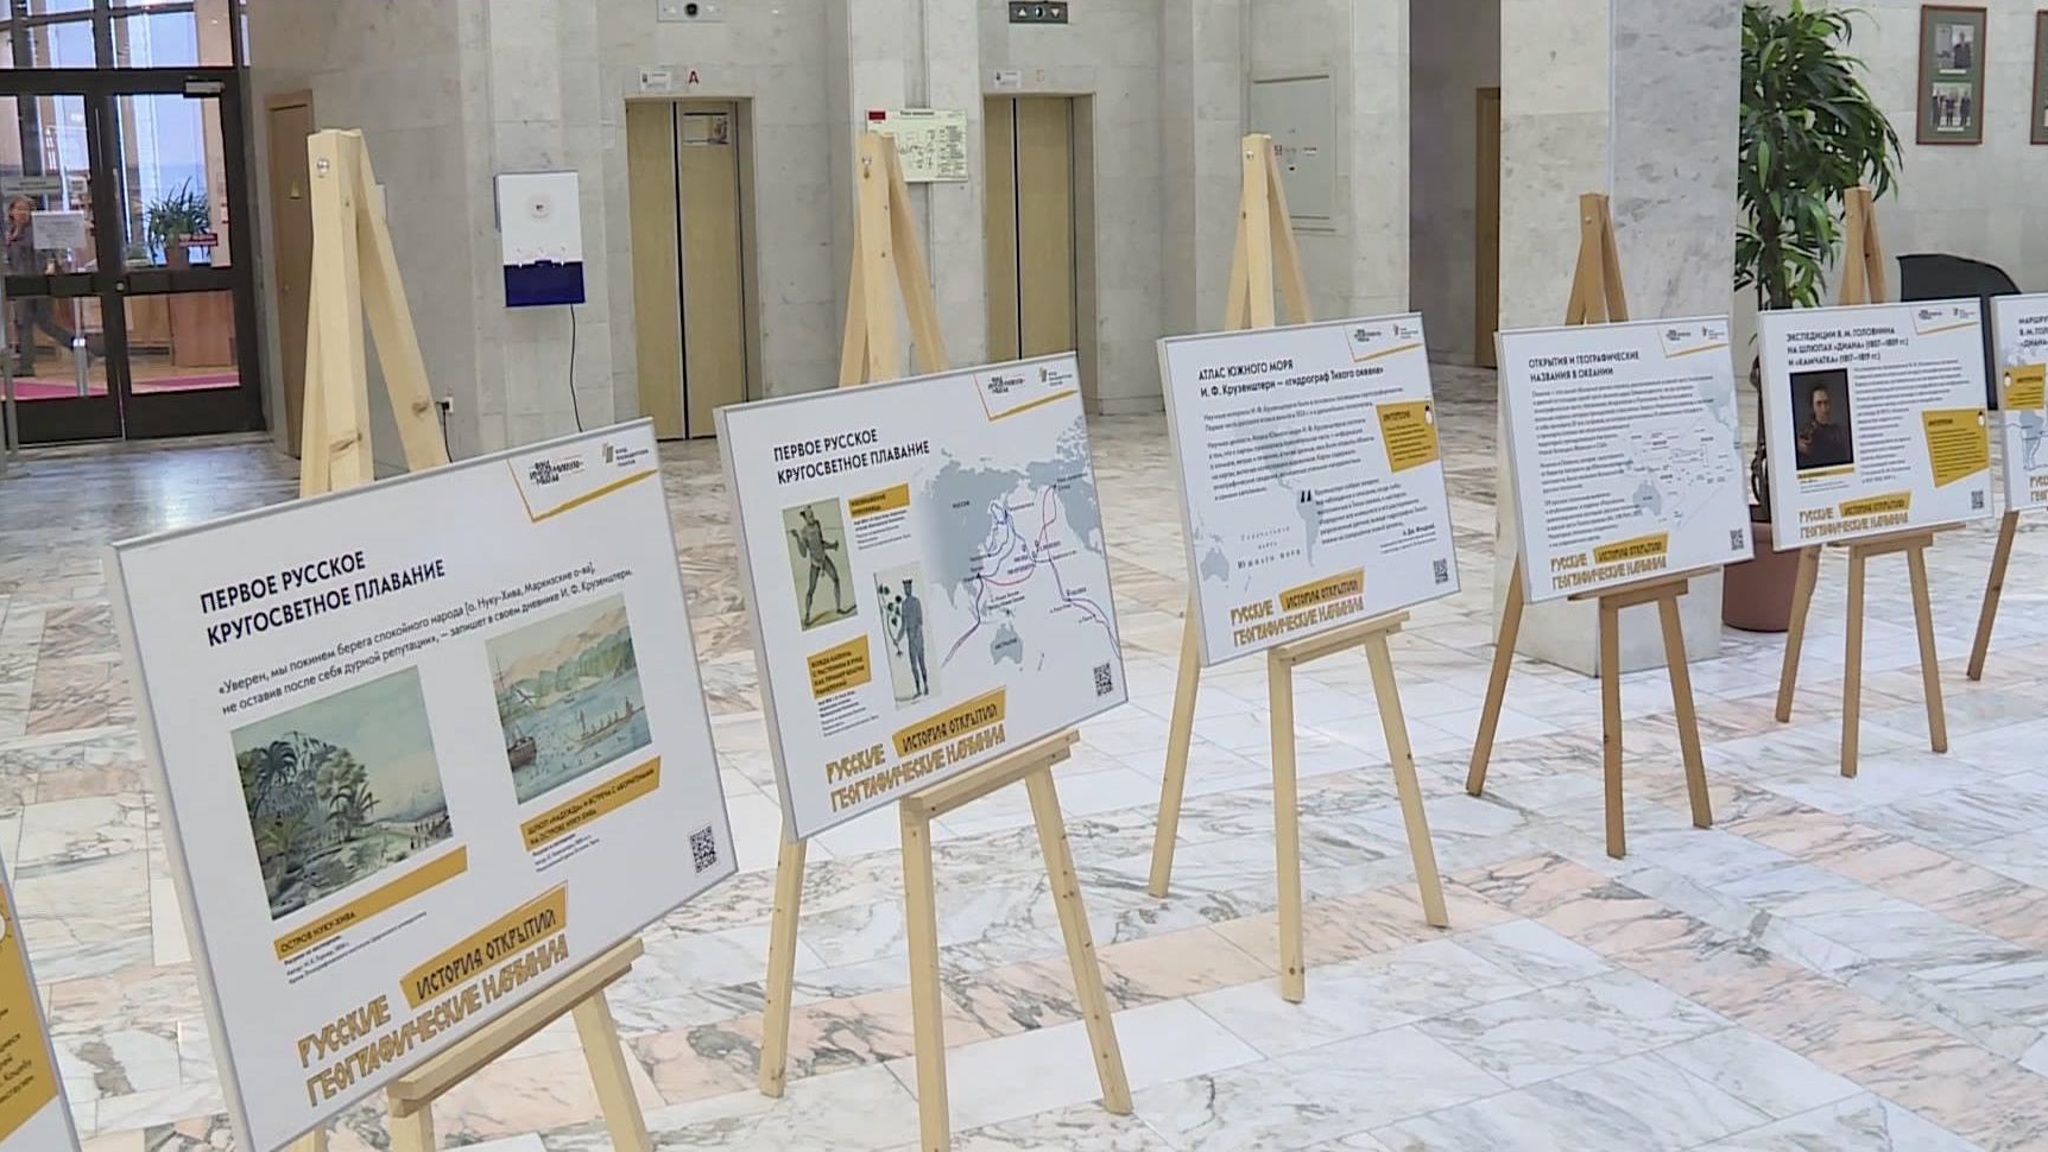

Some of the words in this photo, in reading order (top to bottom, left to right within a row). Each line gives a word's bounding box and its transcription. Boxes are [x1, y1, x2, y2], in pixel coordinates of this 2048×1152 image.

[689, 70, 699, 84] А
[1787, 331, 1835, 342] ЭКСПЕДИЦИИ
[1853, 327, 1895, 337] ГОЛОВНИНА
[1788, 346, 1797, 354] НА
[1799, 343, 1832, 354] ШЛЮПАХ
[1199, 367, 1226, 380] АТЛАС
[1228, 362, 1267, 377] ЮЖНОГО
[1270, 359, 1293, 371] МОРЯ
[1529, 356, 1567, 368] ОТКРЫТИЯ
[1576, 350, 1639, 364] ГЕОГРАФИЧЕСКИЕ
[1530, 370, 1571, 381] НАЗВАНИЯ
[1578, 367, 1613, 378] ОКЕАНИИ
[1222, 381, 1275, 396] Крузенштерн
[774, 439, 822, 462] ПЕРВОЕ
[824, 428, 878, 452] РУССКОЕ
[777, 453, 868, 485] КРУГОСВЕТНОЕ
[870, 440, 930, 465] ПЛАВАНИЕ
[201, 575, 278, 614] ПЕРВОЕ
[282, 550, 366, 591] РУССКОЕ
[207, 587, 351, 647] КРУГОСВЕТНОЕ
[355, 559, 445, 601] ПЛАВАНИЕ
[219, 672, 270, 694] «Уверен,
[271, 665, 288, 678] мы
[290, 651, 336, 673] покинем
[337, 636, 373, 656] берега
[374, 618, 429, 644] спокойного
[430, 606, 464, 626] народа
[524, 571, 573, 593] Маркизские
[222, 703, 238, 715] не
[239, 688, 283, 710] оставив
[284, 676, 316, 694] после
[318, 665, 343, 682] себя
[344, 651, 381, 676] дурной
[450, 616, 486, 638] запишет
[494, 606, 521, 622] своем
[522, 594, 559, 613] дневнике
[902, 723, 947, 752] ИСТОРИЯ
[948, 703, 998, 732] ОТКРЫТИЙ
[825, 743, 886, 784] РУССКИЕ
[830, 749, 946, 812] ГЕОГРАФИЧЕСКИЕ
[280, 930, 313, 952] ОСТРОВ
[416, 948, 482, 1000] ИСТОРИЯ
[486, 908, 557, 961] ОТКРЫТИЙ
[298, 994, 391, 1068] РУССКИЕ
[307, 986, 482, 1107] ГЕОГРАФИЧЕСКИЕ
